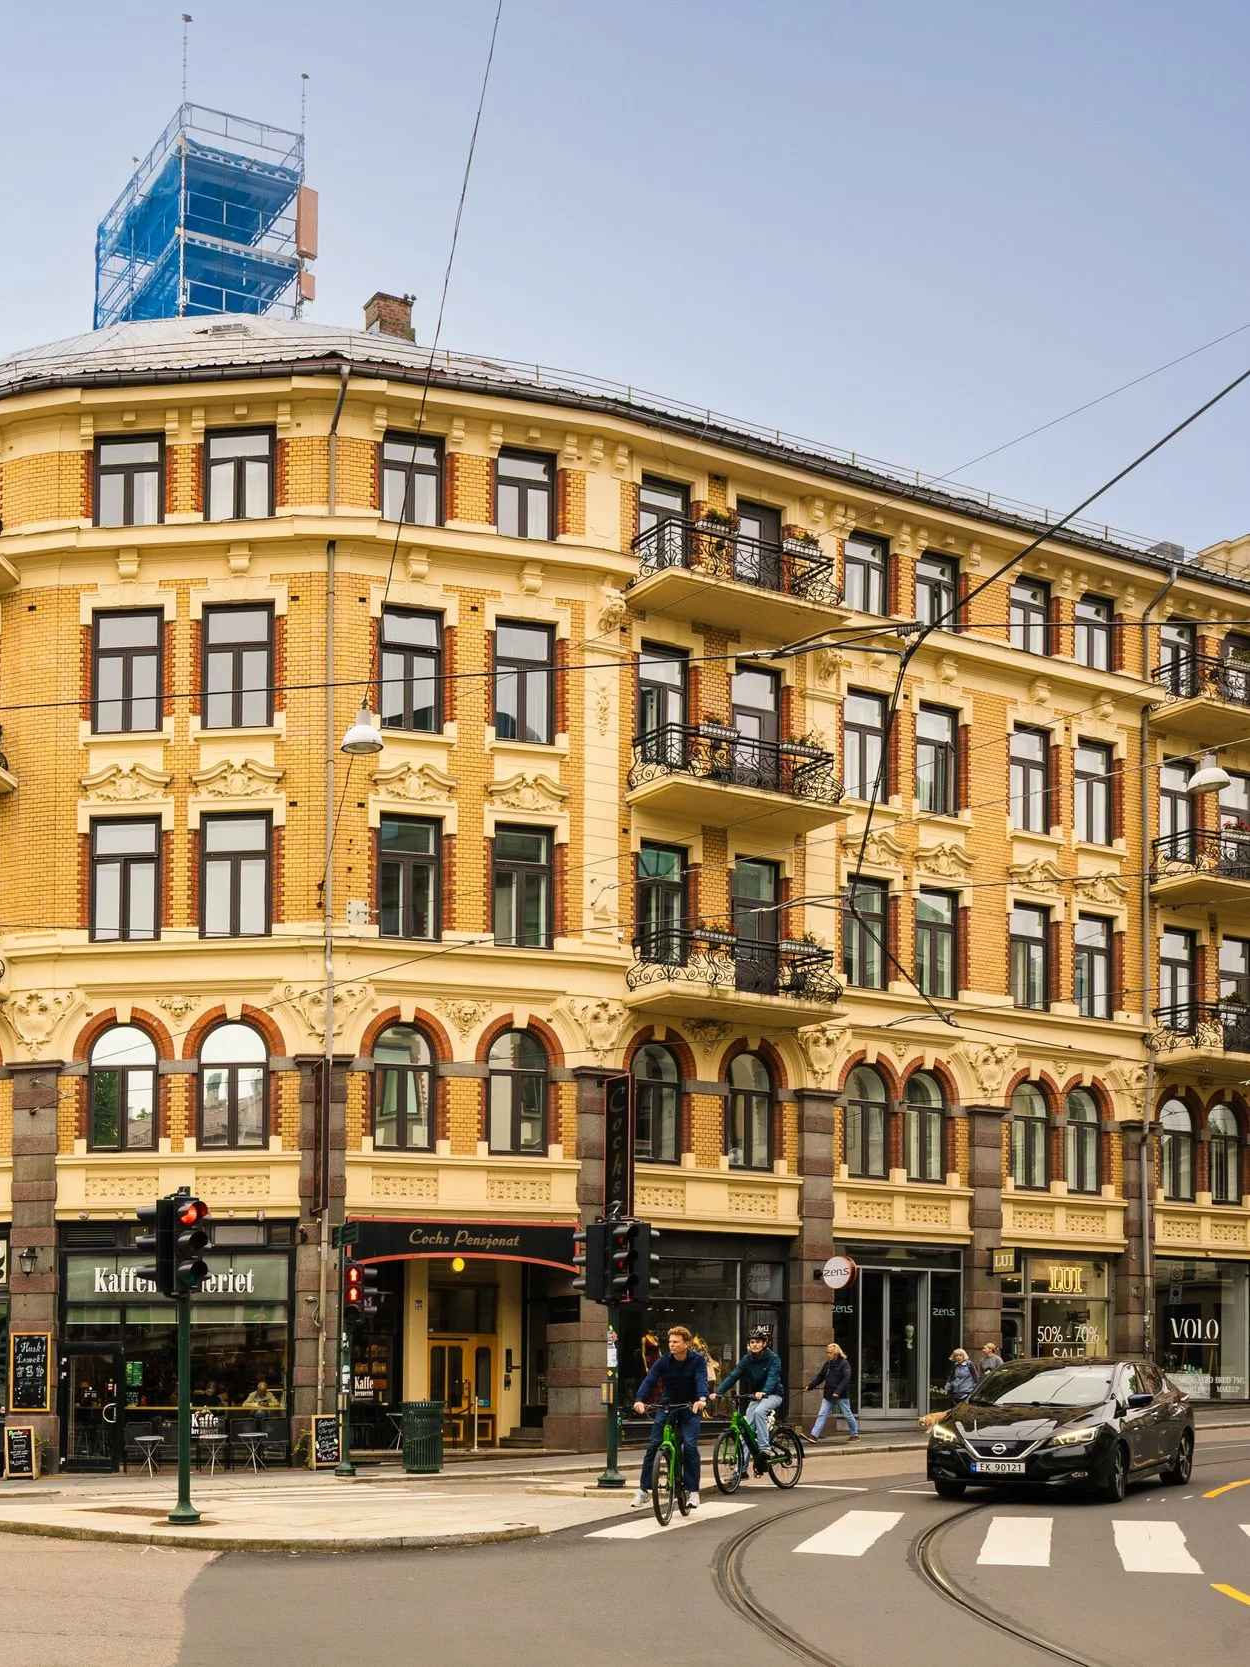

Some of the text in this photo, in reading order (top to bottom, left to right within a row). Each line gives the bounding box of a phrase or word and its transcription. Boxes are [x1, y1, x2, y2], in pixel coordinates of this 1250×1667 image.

[609, 1086, 626, 1194] Cochs
[409, 1228, 521, 1249] Cochs Pensjonat
[994, 1254, 1014, 1267] LUI
[94, 1267, 255, 1293] Kaffeeriet
[823, 1267, 850, 1277] zens
[1049, 1266, 1083, 1292] LUI
[932, 1307, 956, 1316] zens
[1037, 1325, 1063, 1343] 50%
[1074, 1325, 1100, 1343] 70%
[1170, 1318, 1219, 1339] VOLO
[354, 1376, 374, 1389] Kaffe
[191, 1413, 219, 1427] Kaffe
[980, 1463, 1021, 1472] EK 90121
